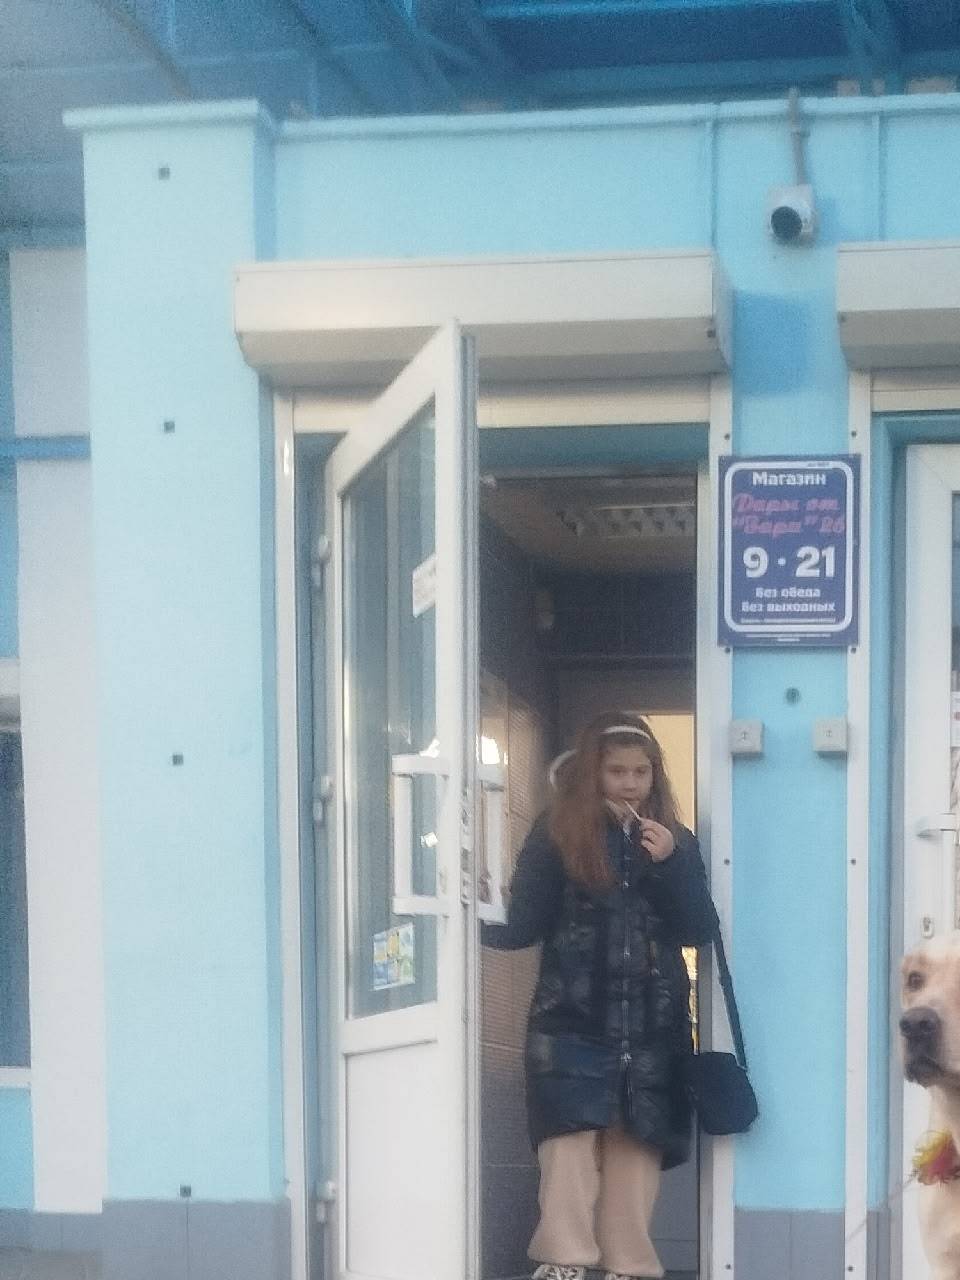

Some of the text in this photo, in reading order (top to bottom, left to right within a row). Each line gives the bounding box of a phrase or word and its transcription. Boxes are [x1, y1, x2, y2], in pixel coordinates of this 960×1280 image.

[753, 471, 827, 486] Магазин
[743, 546, 836, 578] 9 21
[780, 586, 821, 598] обеда
[766, 602, 836, 612] выходных
